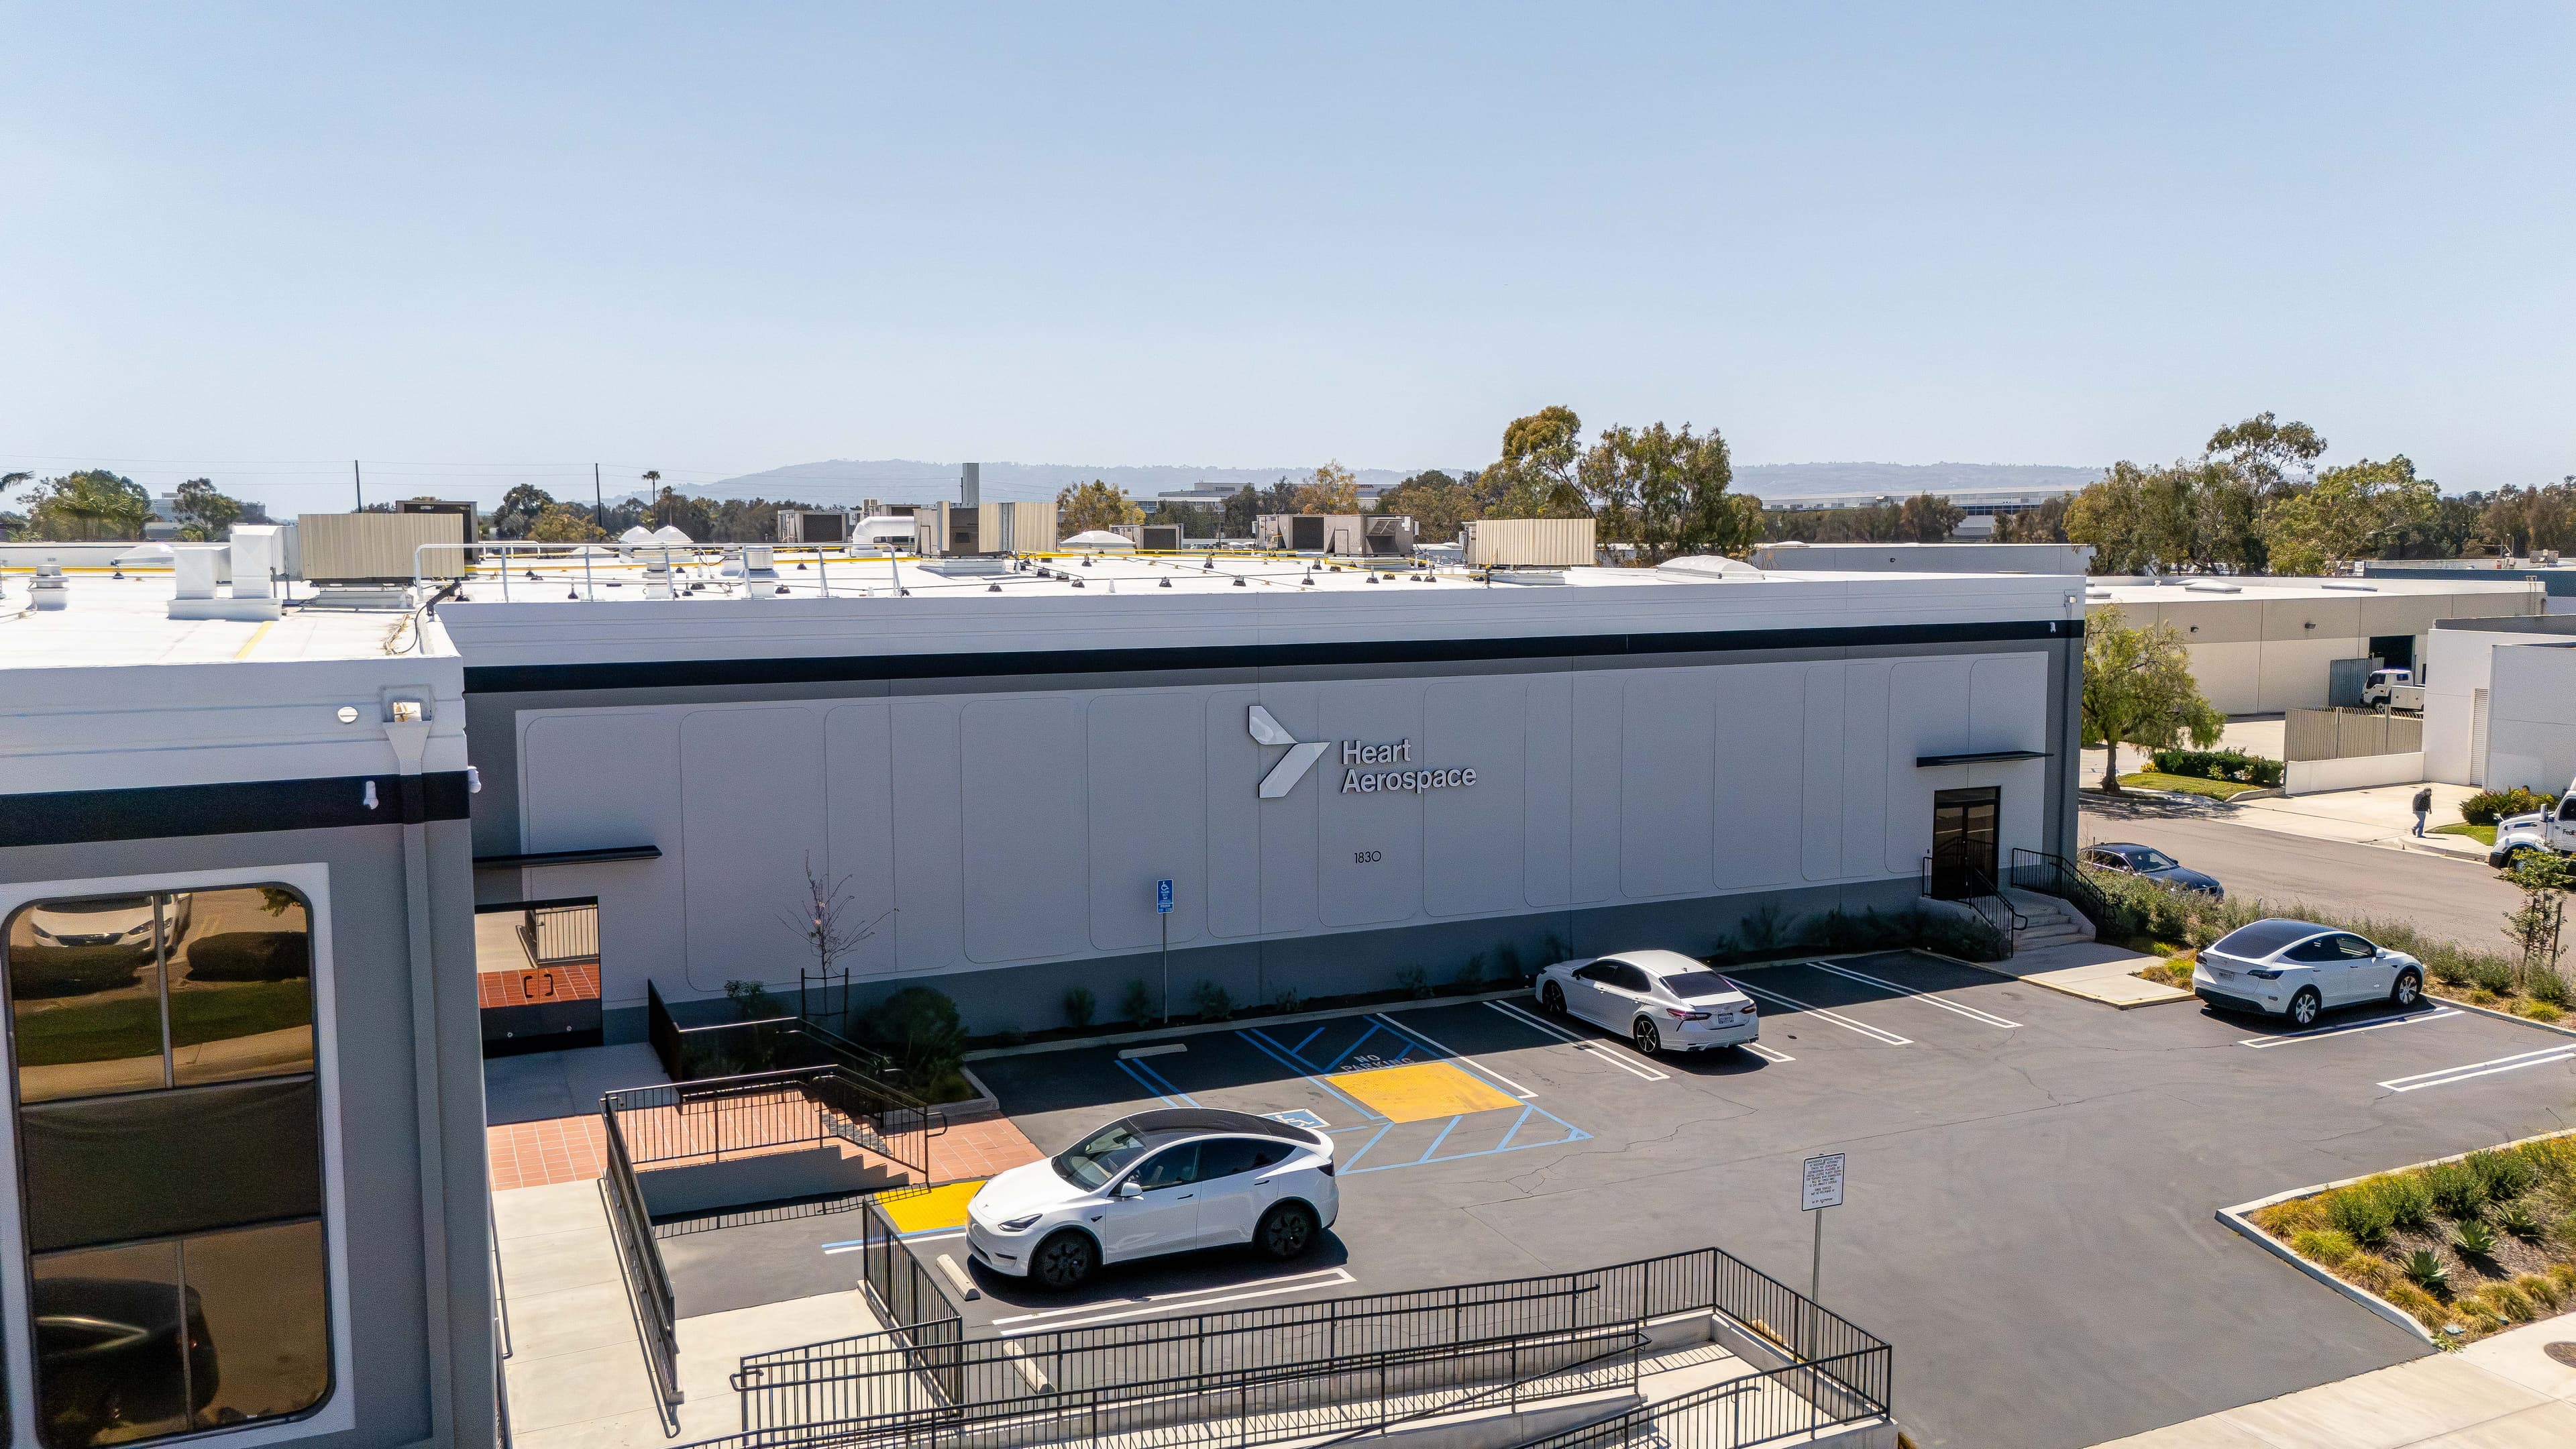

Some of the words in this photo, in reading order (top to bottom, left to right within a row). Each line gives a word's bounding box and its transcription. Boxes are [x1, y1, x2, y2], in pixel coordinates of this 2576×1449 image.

[1342, 739, 1411, 765] Heart
[1341, 767, 1477, 794] Aerospace
[1354, 851, 1381, 863] 1830
[1340, 1058, 1415, 1073] PARKING
[1354, 1055, 1381, 1063] NO
